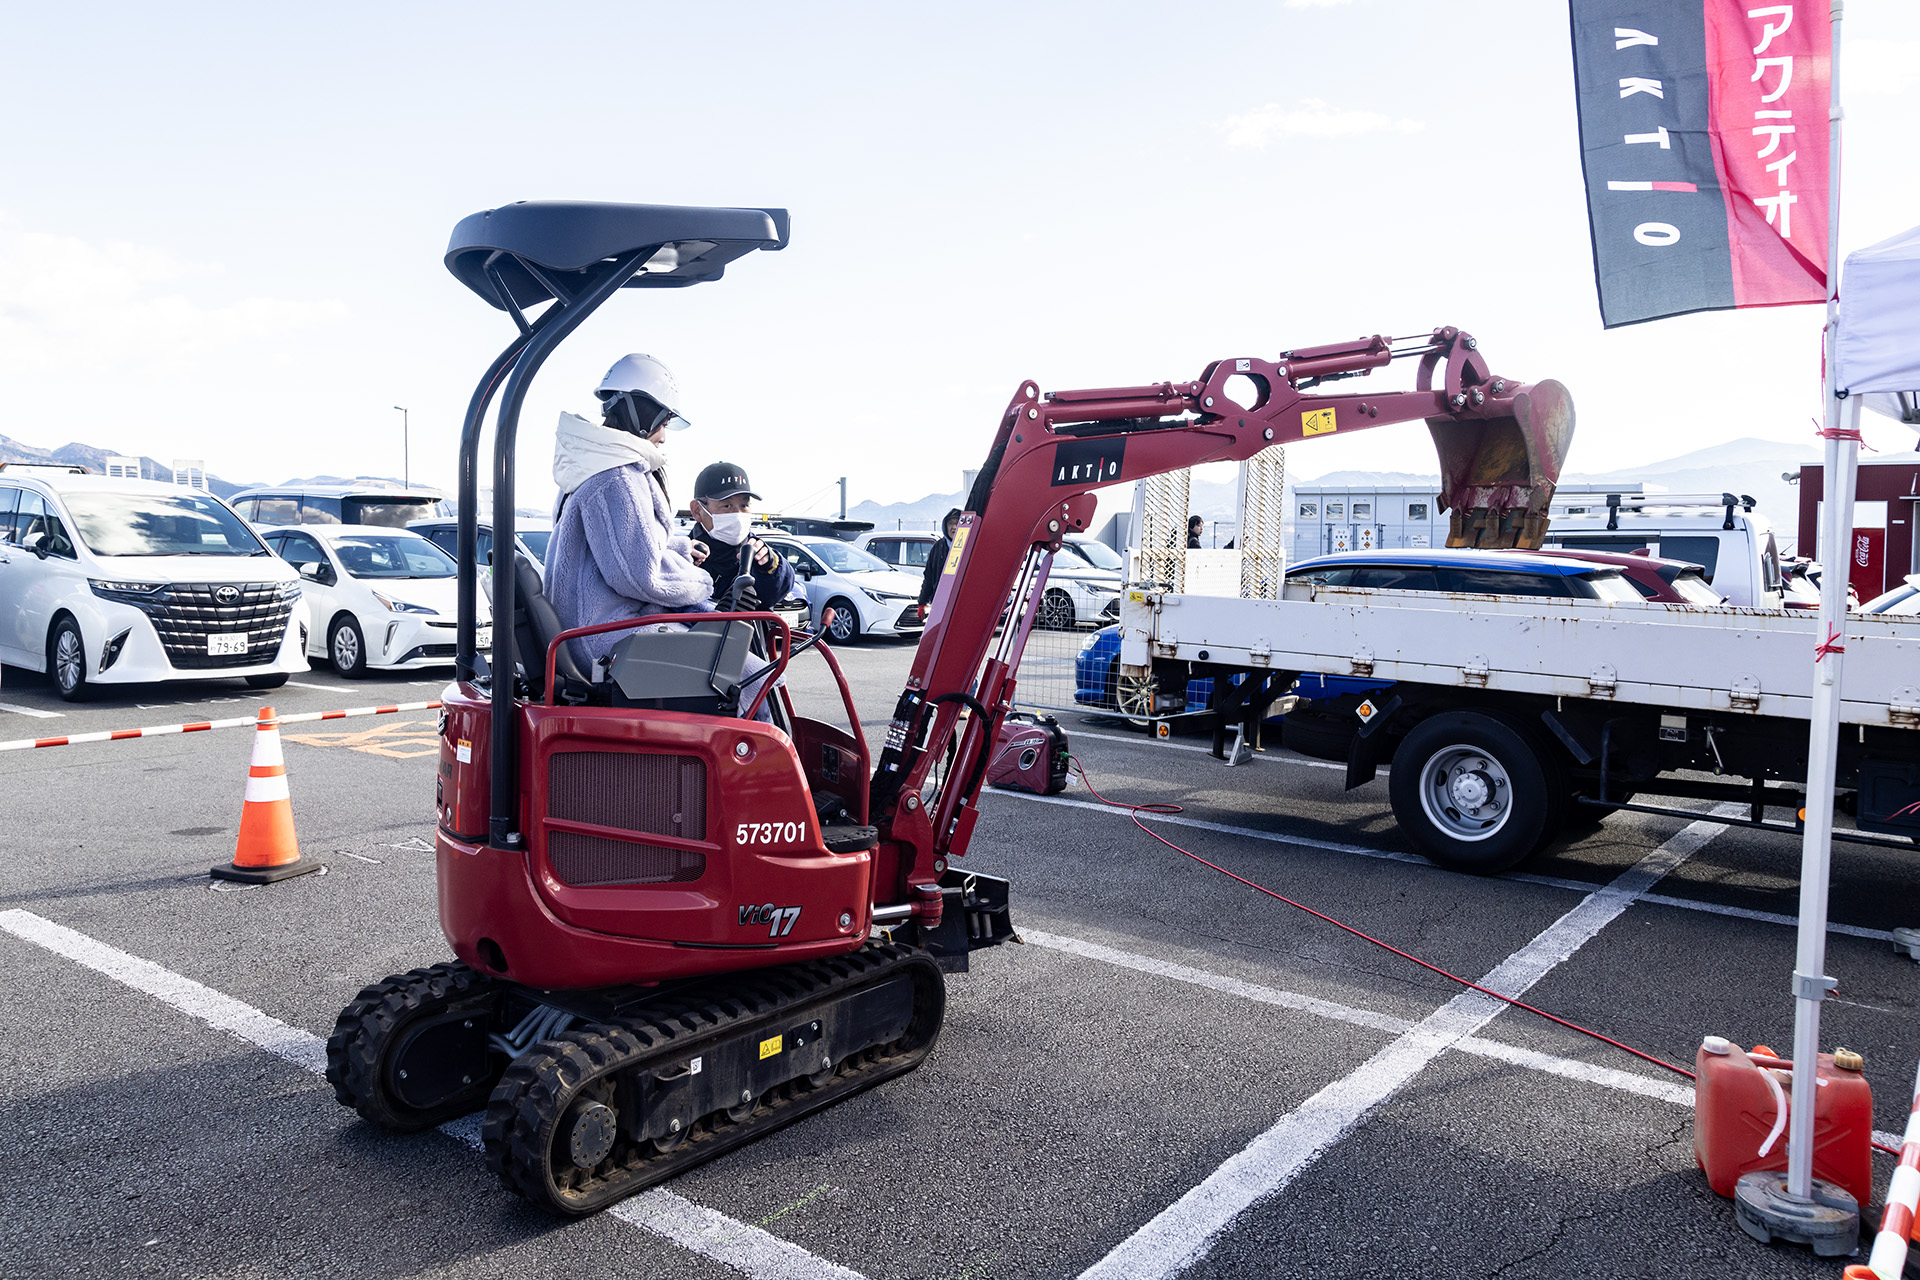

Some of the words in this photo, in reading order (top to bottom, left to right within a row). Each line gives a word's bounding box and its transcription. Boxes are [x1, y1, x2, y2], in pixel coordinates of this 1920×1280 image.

[1747, 5, 1798, 238] アクティオ
[1607, 27, 1698, 247] AKTIO
[721, 475, 747, 485] AKTIO
[1057, 456, 1117, 483] AKTIO
[217, 641, 246, 654] 79-69
[736, 821, 806, 845] 573701
